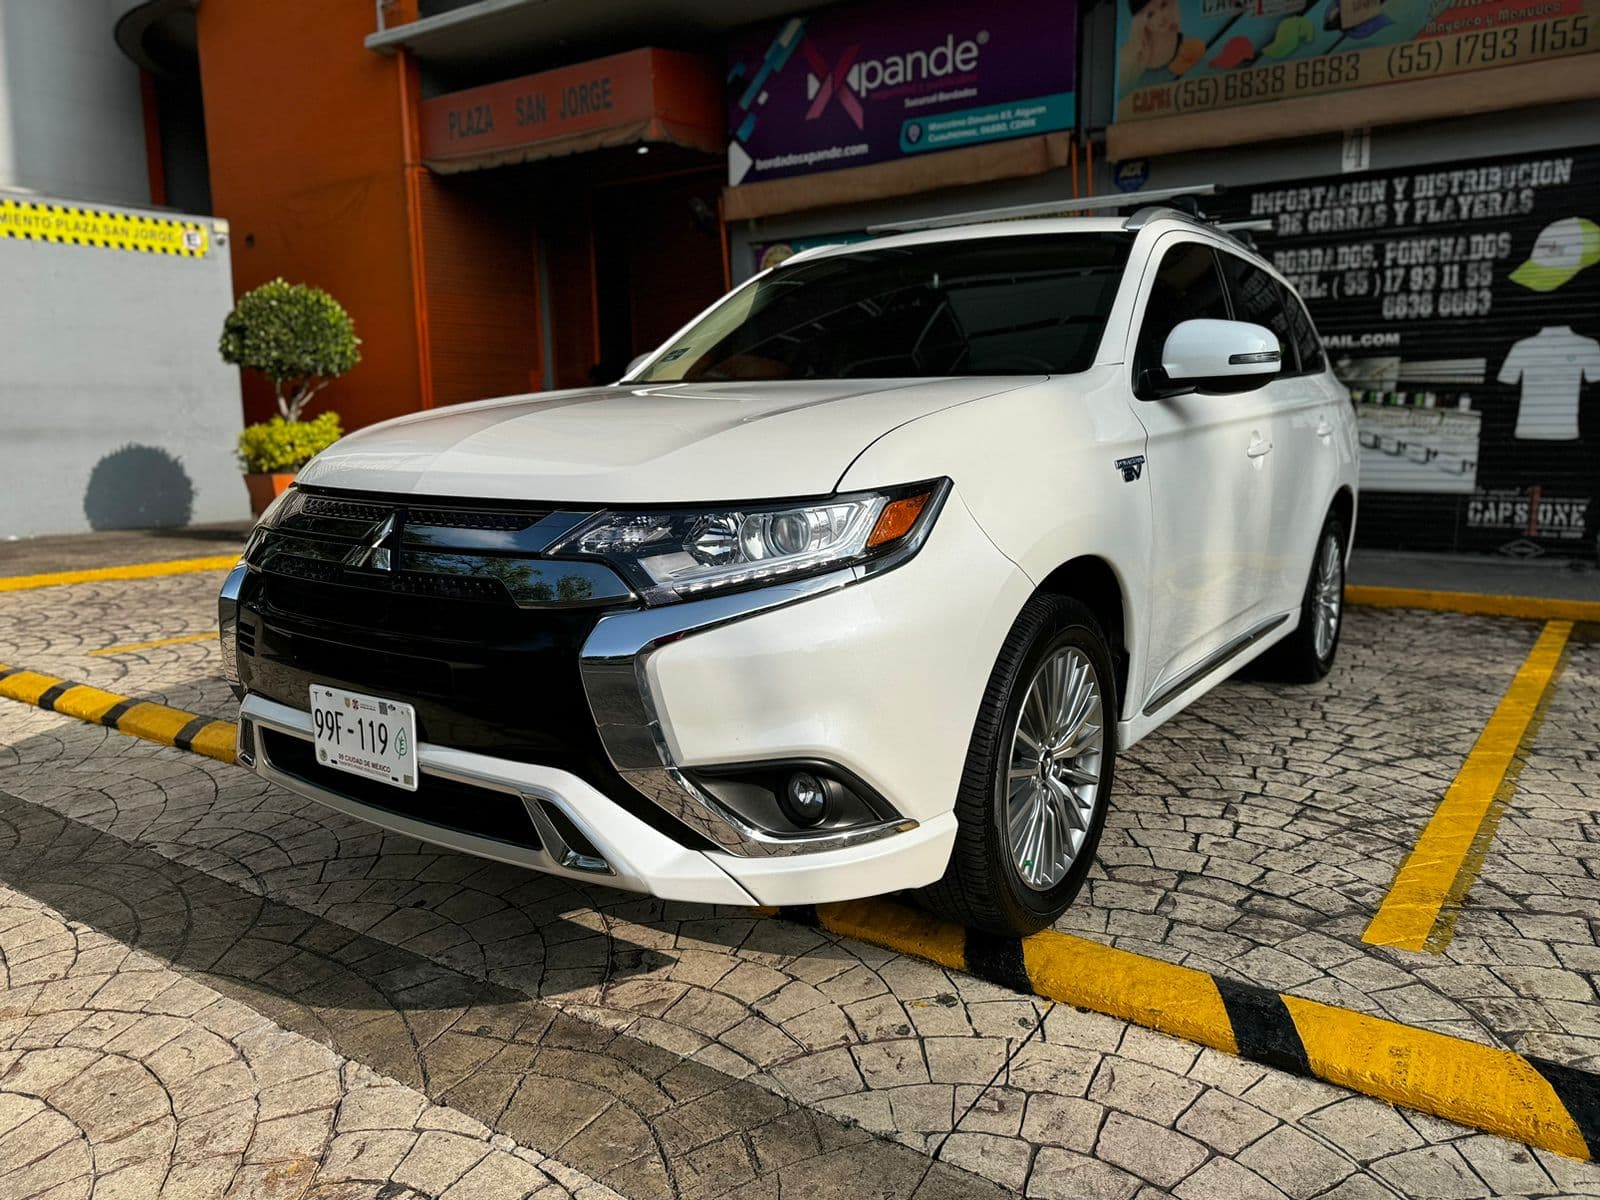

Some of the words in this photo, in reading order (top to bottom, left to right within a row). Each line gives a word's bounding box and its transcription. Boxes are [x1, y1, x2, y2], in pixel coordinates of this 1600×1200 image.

[1174, 77, 1218, 112] (55)
[1224, 65, 1286, 101] 6838
[1295, 53, 1361, 90] 6683
[1386, 40, 1443, 79] (55)
[1455, 27, 1519, 66] 1793
[1532, 15, 1589, 54] 1155
[449, 104, 494, 138] PLAZA
[516, 93, 547, 127] SAN
[560, 77, 613, 120] JORGE
[1250, 178, 1388, 215] IMPORTACION
[1392, 176, 1409, 200] Y
[1412, 157, 1574, 199] DISTRIBUCION
[56, 219, 99, 235] PLAZA
[102, 223, 130, 239] SAN
[133, 226, 176, 243] JORGE
[1276, 212, 1304, 237] DE
[1306, 203, 1388, 234] GORRAS
[1392, 200, 1410, 226] Y
[1413, 188, 1535, 225] PLAYERAS
[1409, 264, 1437, 292] 93
[1464, 260, 1494, 288] 55
[1381, 294, 1433, 320] 6838
[1437, 287, 1493, 317] 6683
[314, 707, 389, 756] 99F-119
